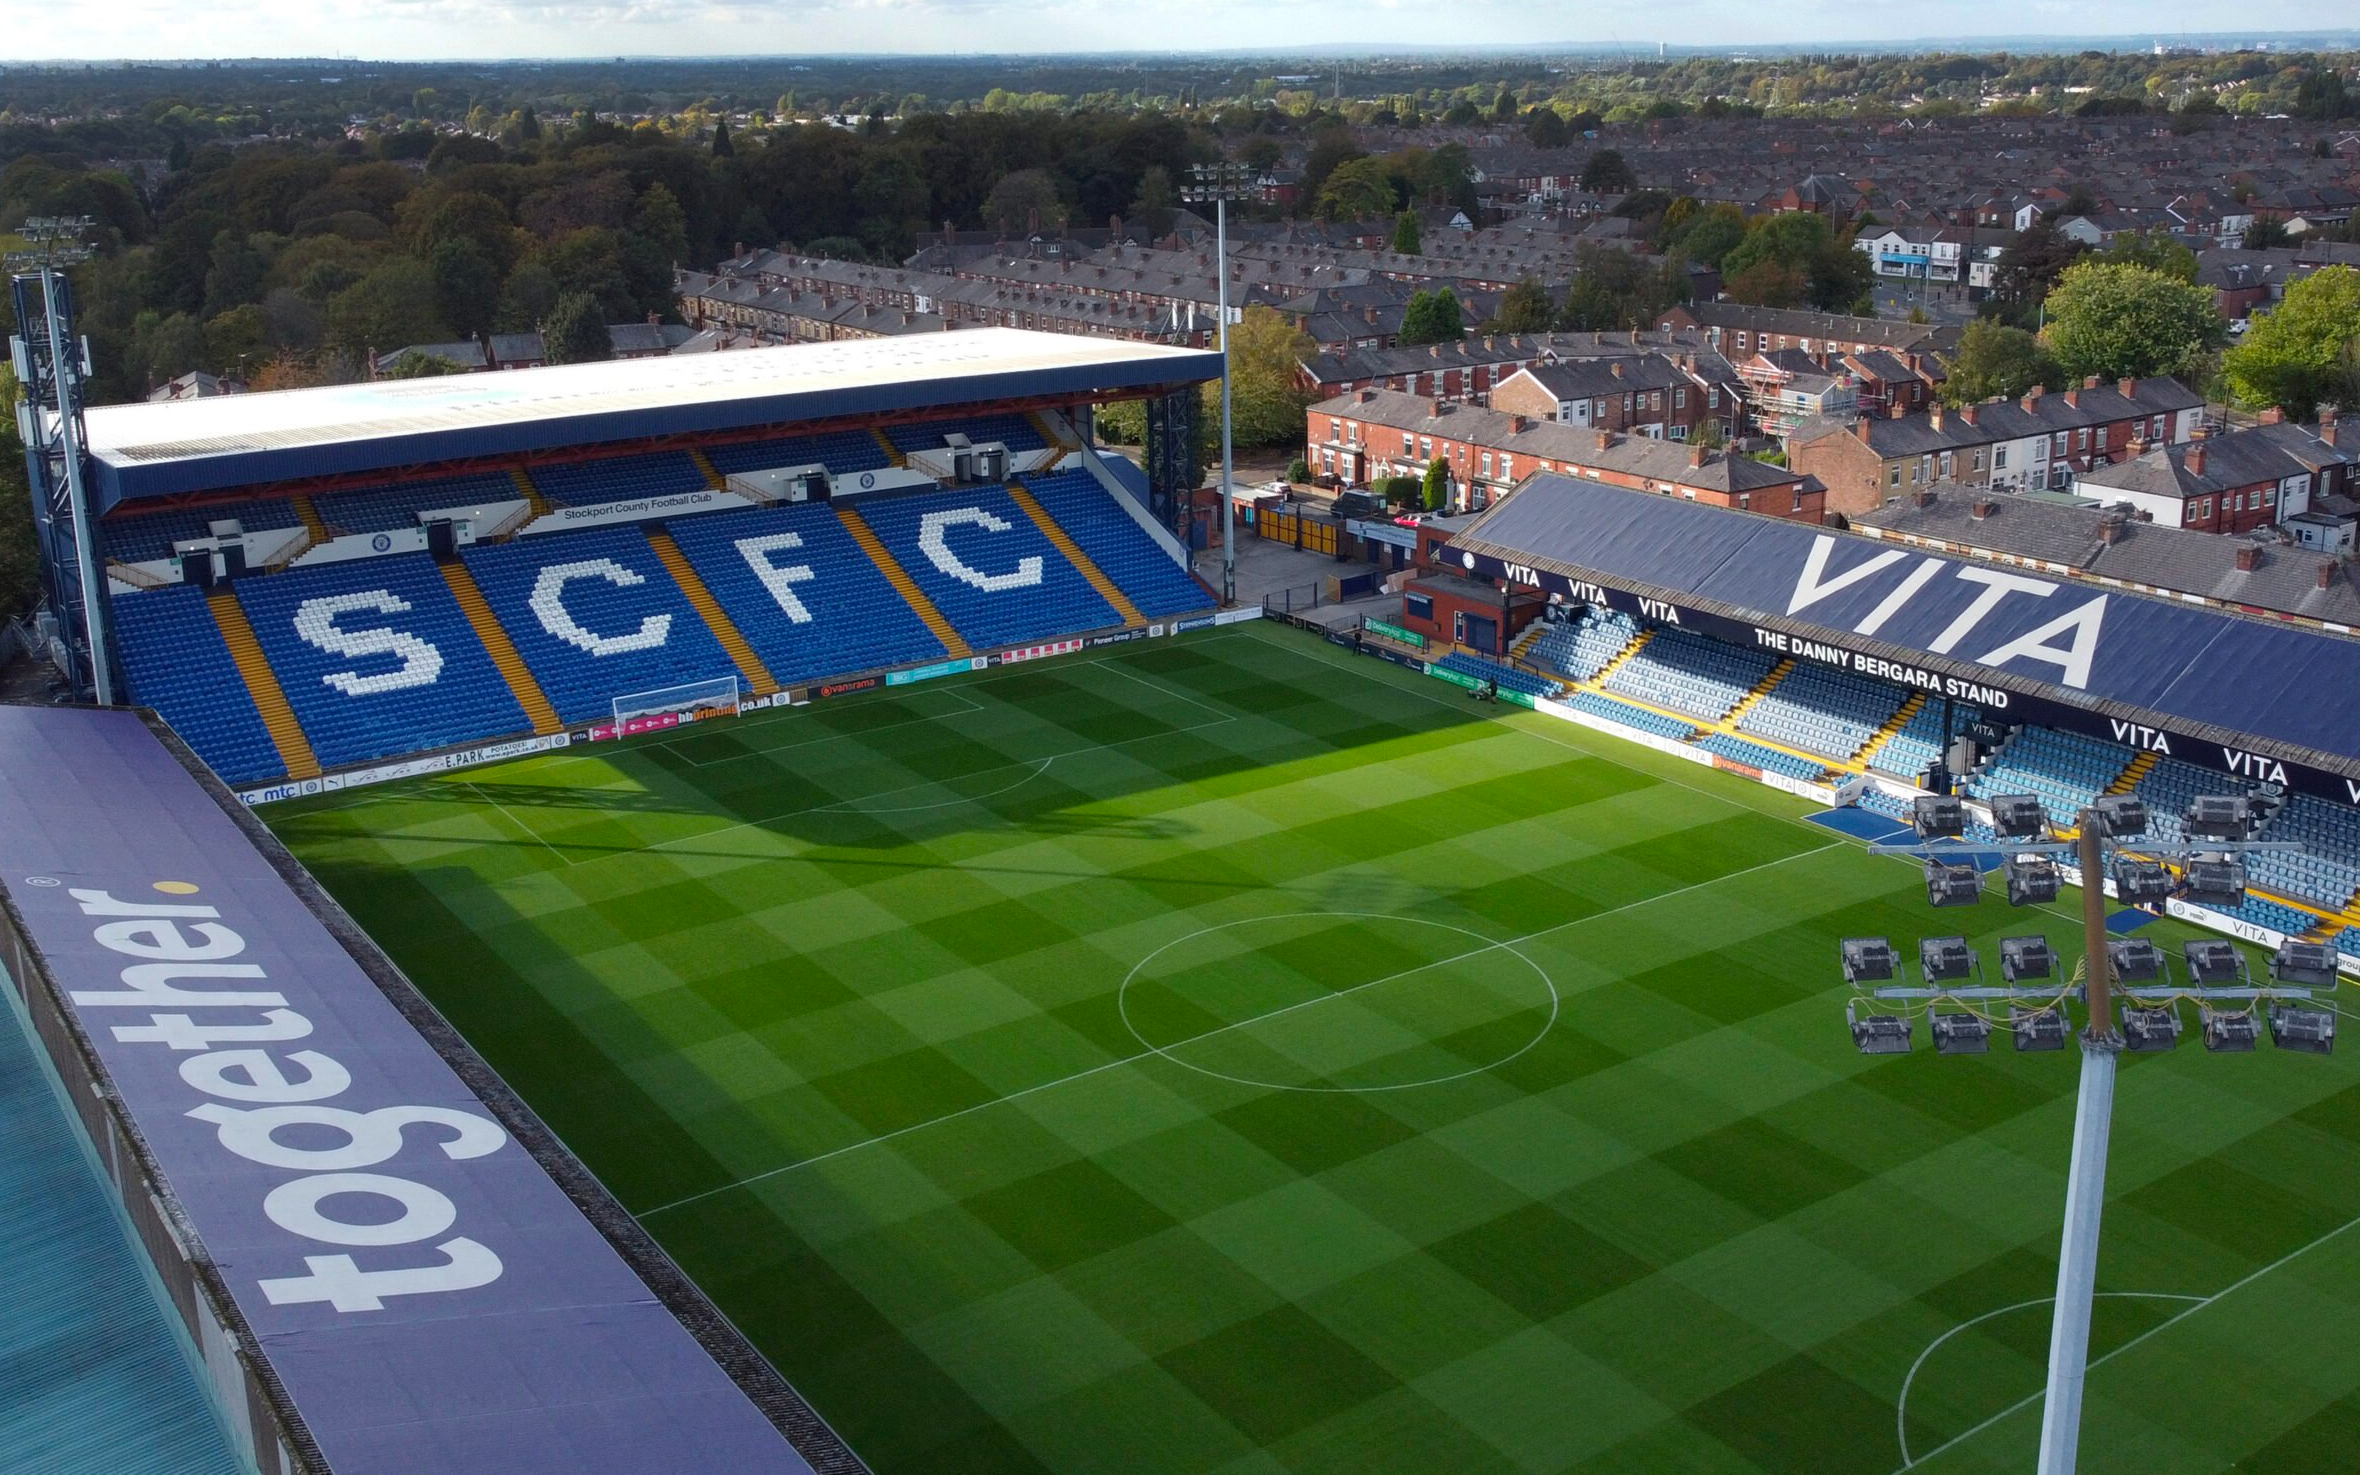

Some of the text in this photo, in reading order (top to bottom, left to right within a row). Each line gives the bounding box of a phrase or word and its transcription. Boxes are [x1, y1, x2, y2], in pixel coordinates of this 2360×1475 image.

[564, 493, 712, 520] Stockport County Football Club
[1503, 561, 1541, 588] VITA
[1568, 578, 1607, 606] VITA
[1638, 596, 1680, 625] VITA
[1786, 535, 2109, 689] VITA
[1754, 628, 2009, 709] THE DANNY BERGARA STAND
[571, 733, 588, 741] VITA
[1971, 722, 1996, 738] VITA
[2110, 718, 2171, 754] VITA
[445, 749, 485, 768] E.PARK
[1684, 746, 1707, 762] VITA
[2223, 748, 2289, 786] VITA
[1721, 758, 1764, 781] vanarama
[1767, 772, 1793, 790] VITA
[2232, 920, 2269, 944] VITA
